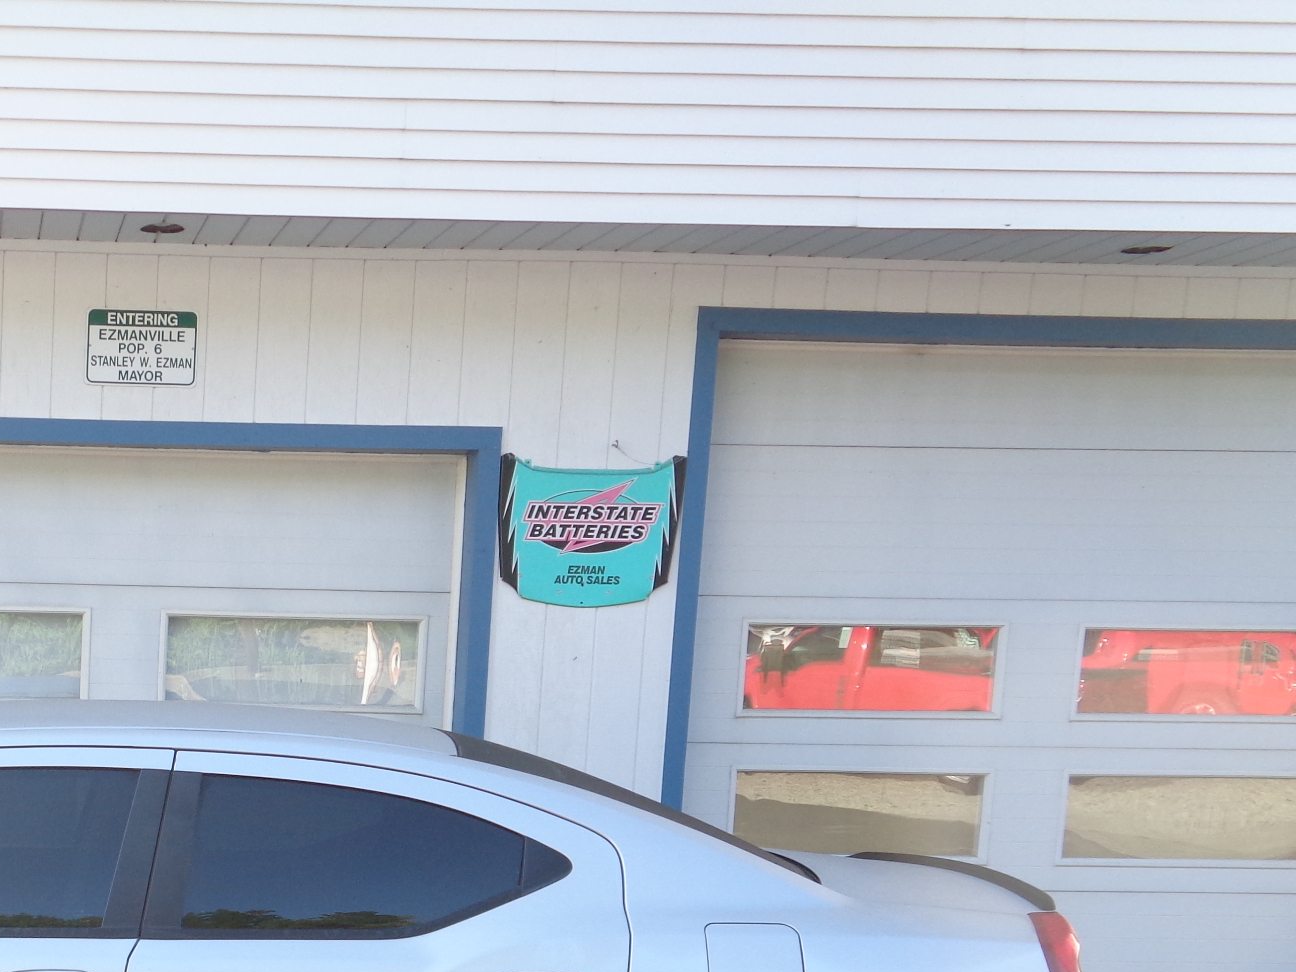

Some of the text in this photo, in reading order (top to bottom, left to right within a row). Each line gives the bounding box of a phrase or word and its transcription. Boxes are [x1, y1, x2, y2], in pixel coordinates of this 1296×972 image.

[107, 312, 178, 326] ENTERING
[98, 328, 186, 342] EZMANVILLE
[118, 343, 162, 354] POP. 6
[90, 355, 192, 369] STANLEY W. EZMAN
[118, 370, 163, 381] MAYOR
[526, 504, 658, 521] INTERSTATE
[529, 523, 646, 540] BATTERIES
[567, 565, 605, 574] EZMAN
[554, 575, 621, 585] AUTO SALES
